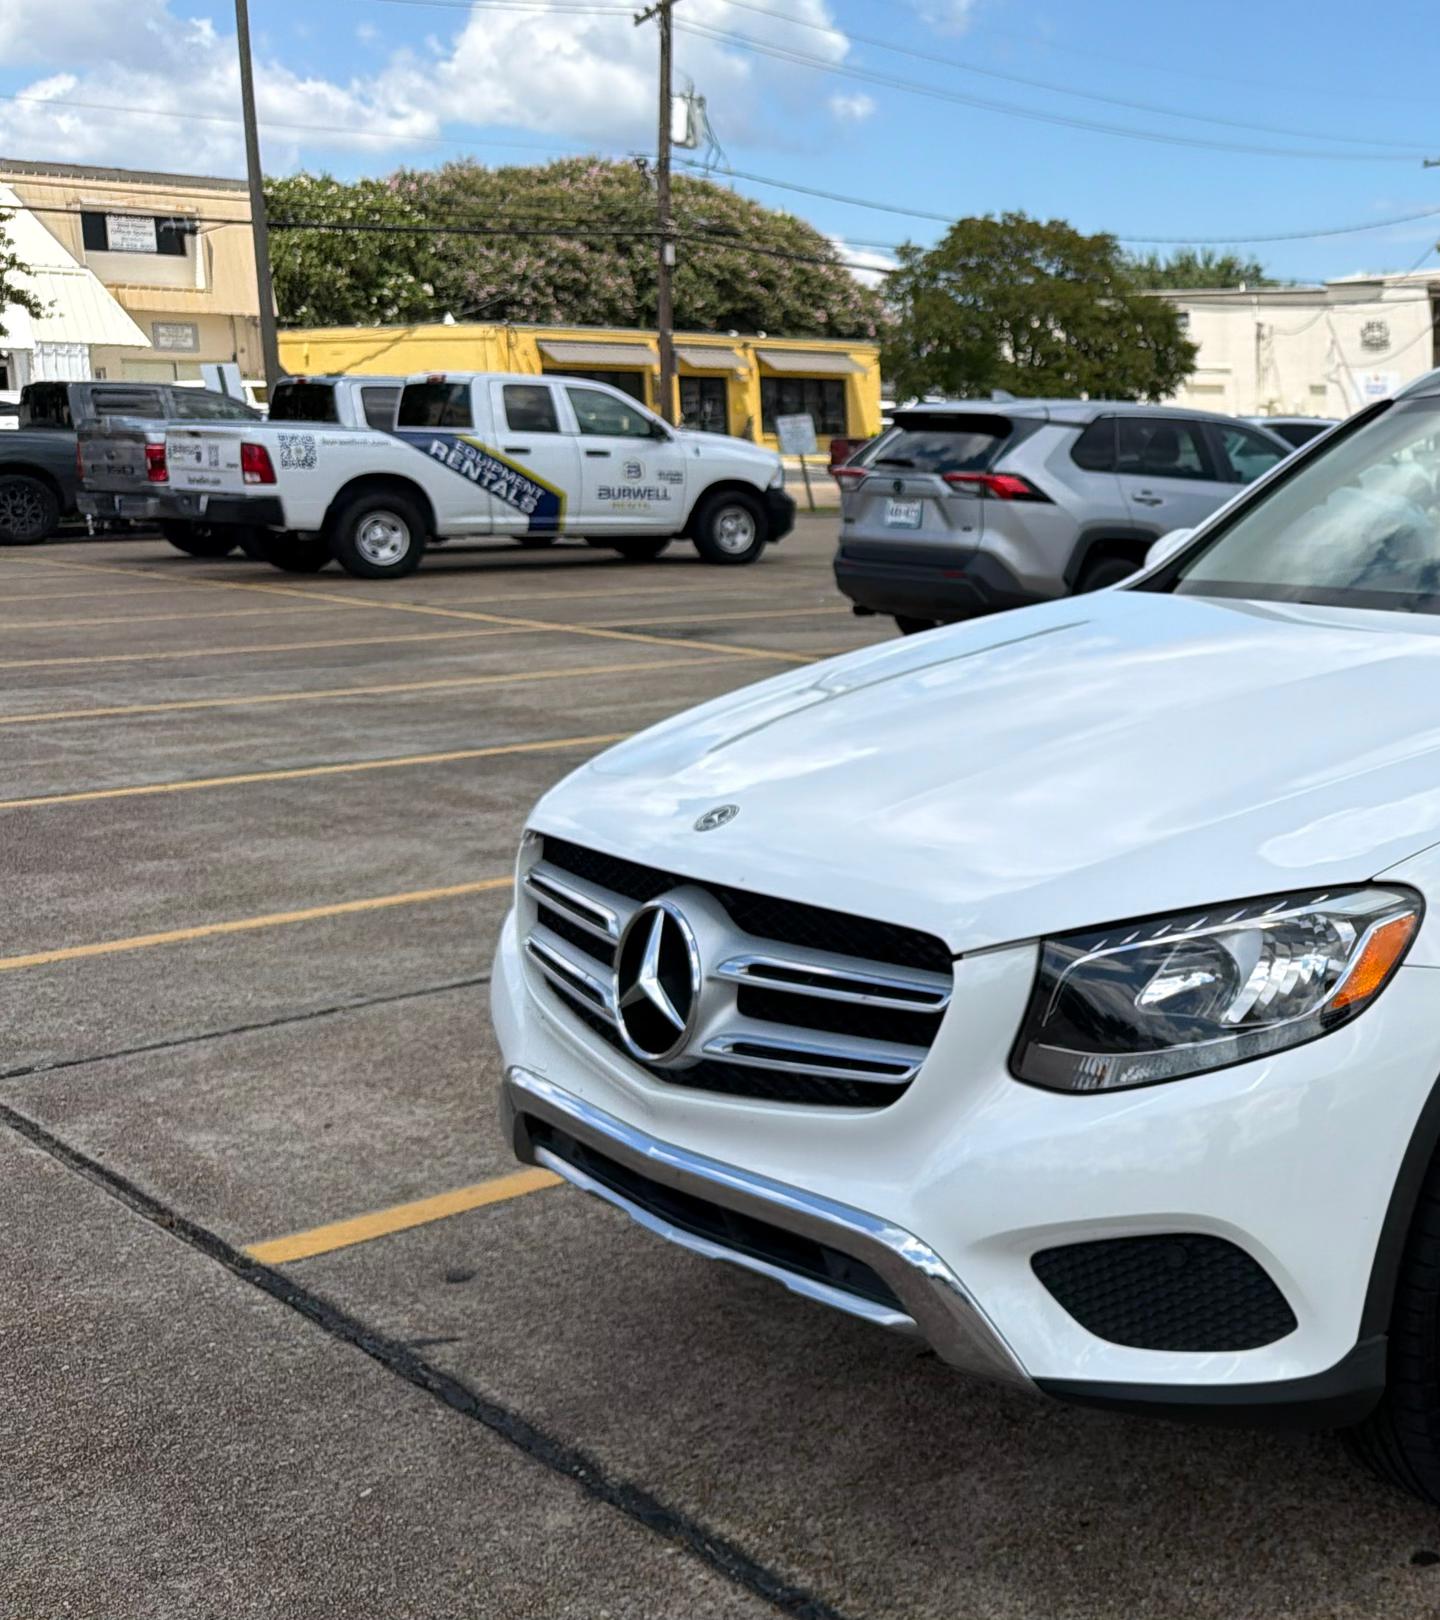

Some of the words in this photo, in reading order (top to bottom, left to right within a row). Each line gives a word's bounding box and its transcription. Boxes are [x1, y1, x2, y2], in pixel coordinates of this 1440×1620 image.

[429, 439, 538, 515] RENTALS
[455, 440, 546, 500] EQUIPMENT
[597, 485, 671, 501] BURWELL
